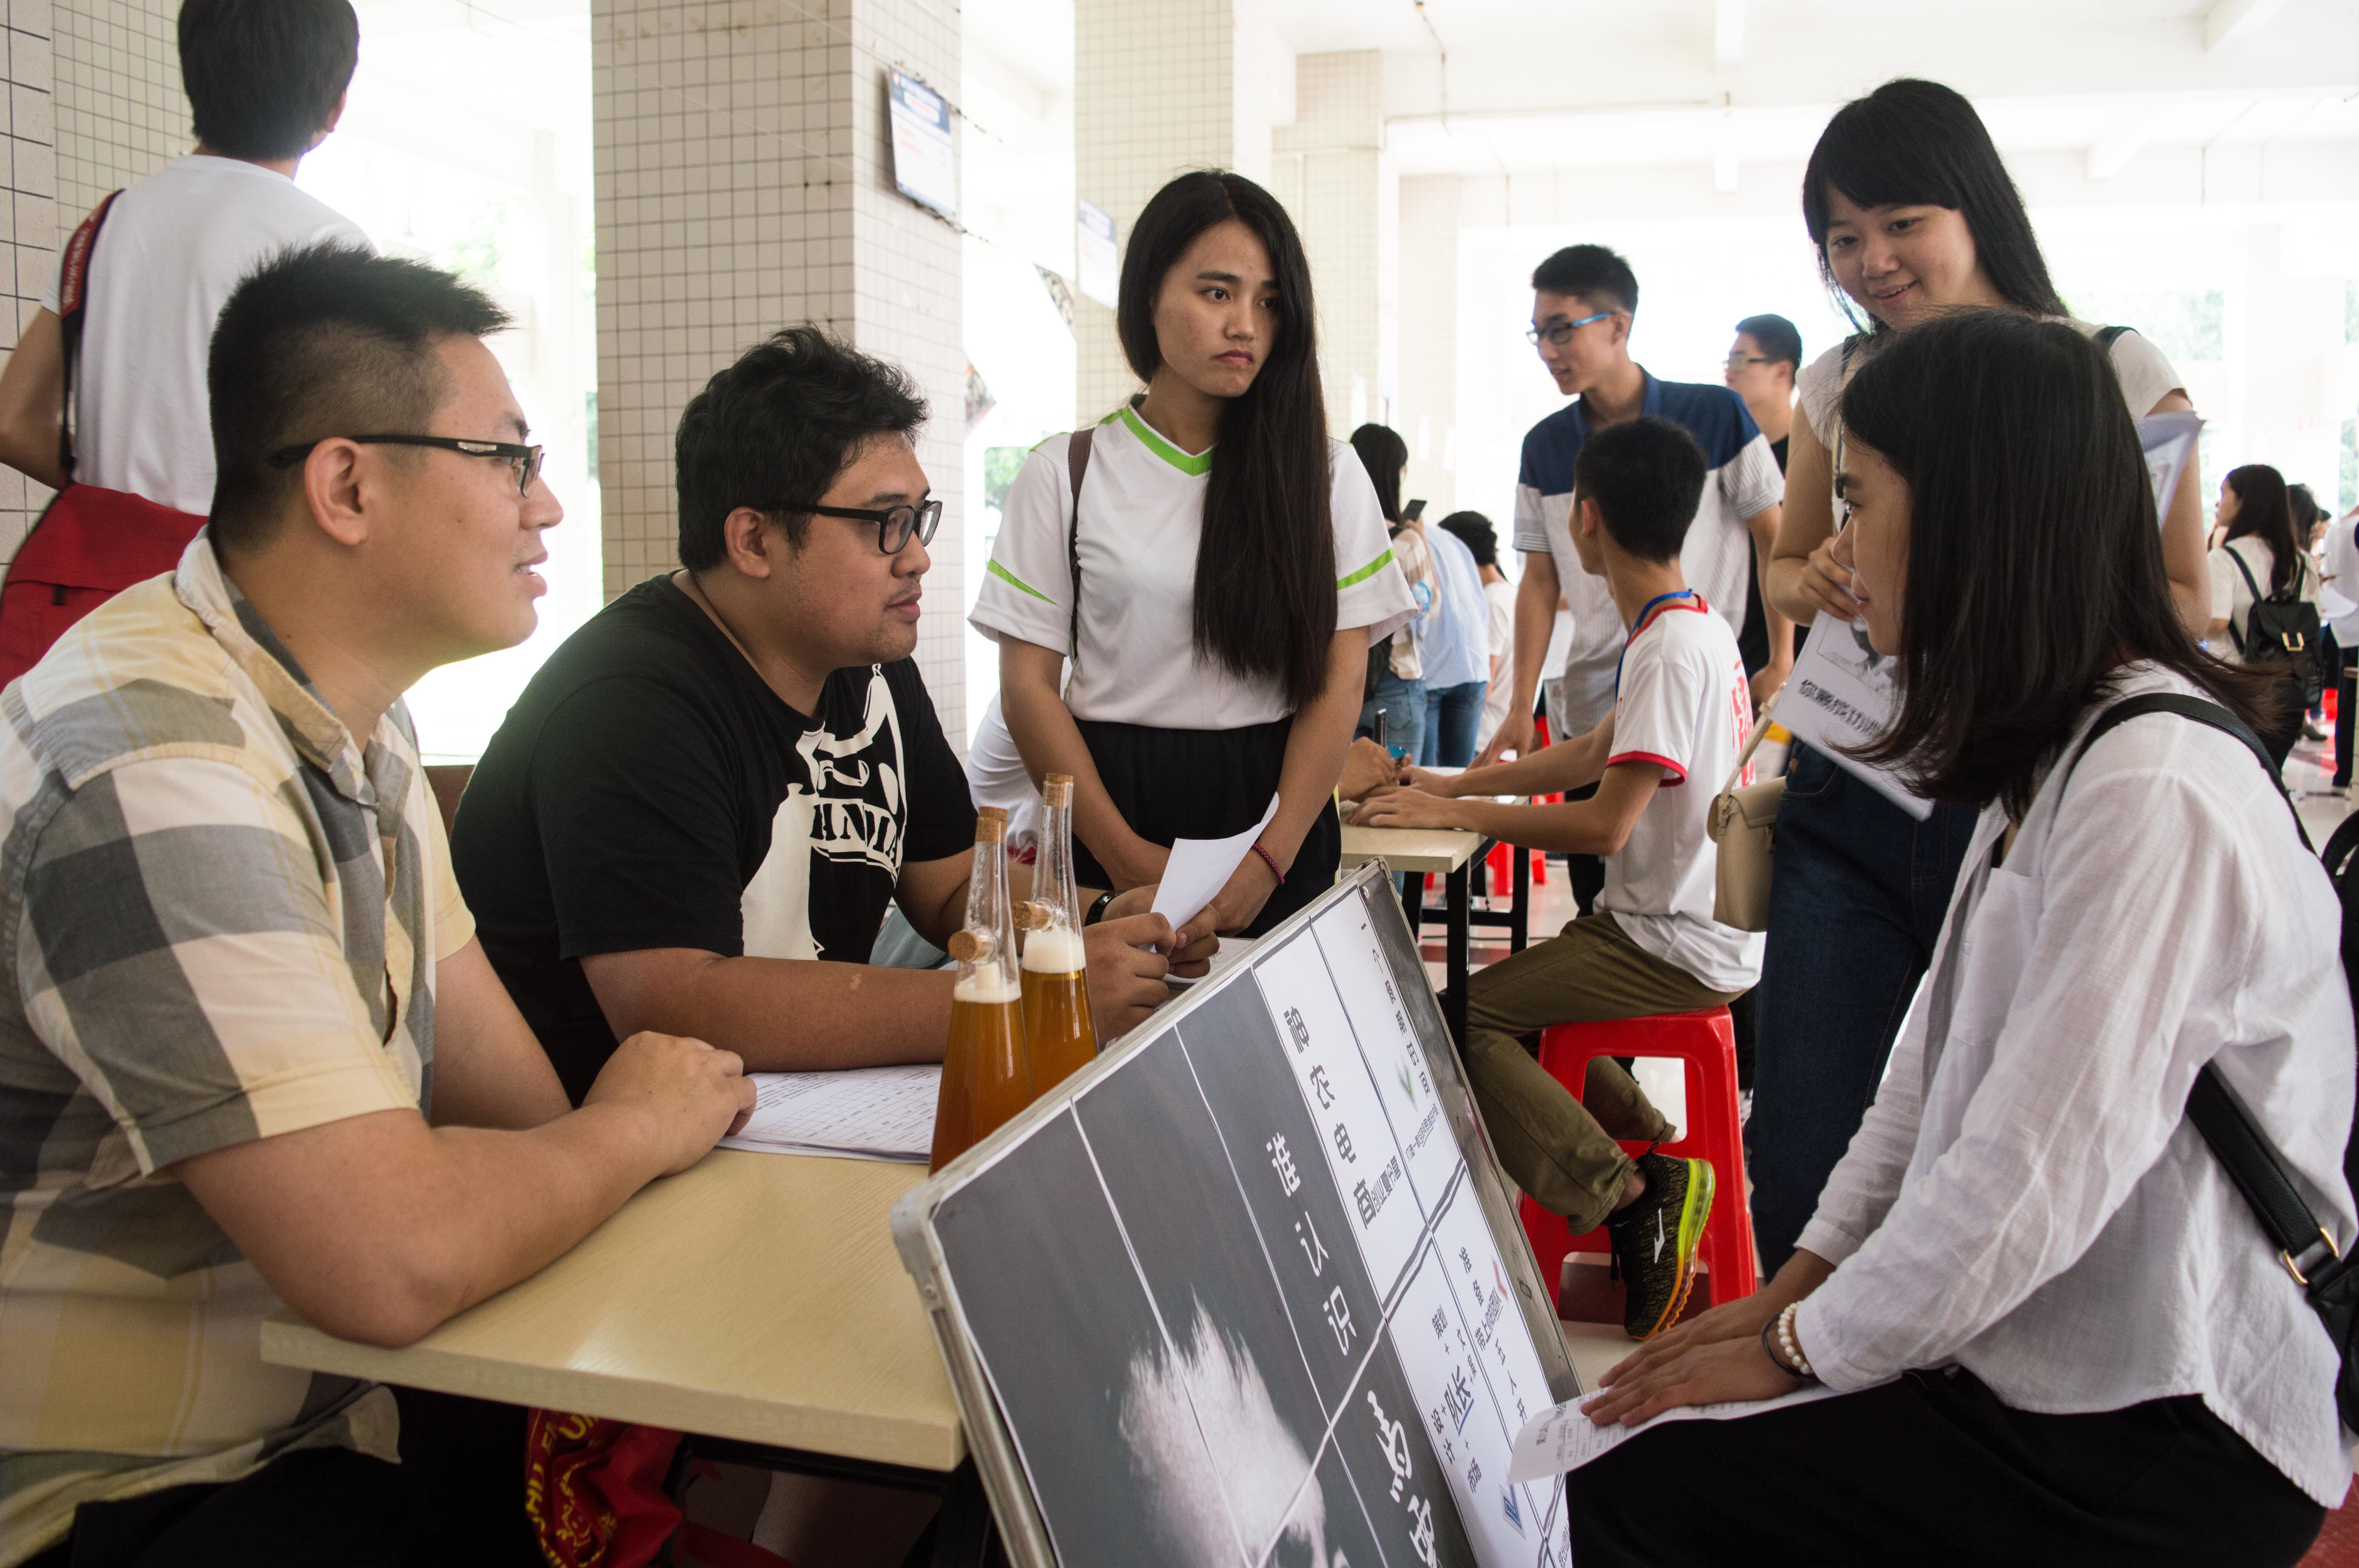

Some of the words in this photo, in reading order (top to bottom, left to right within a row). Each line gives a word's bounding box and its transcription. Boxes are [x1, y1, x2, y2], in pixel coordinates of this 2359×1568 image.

[1283, 1006, 1376, 1230] 神农电商
[1371, 1155, 1401, 1213] 创业夏令营
[1266, 1132, 1357, 1356] 谁认识
[1432, 1304, 1448, 1339] 策划
[1475, 1286, 1501, 1352] 带上你的团队
[1445, 1365, 1471, 1434] 队长
[1430, 1408, 1455, 1465] 设计
[1467, 1457, 1482, 1494] 市场
